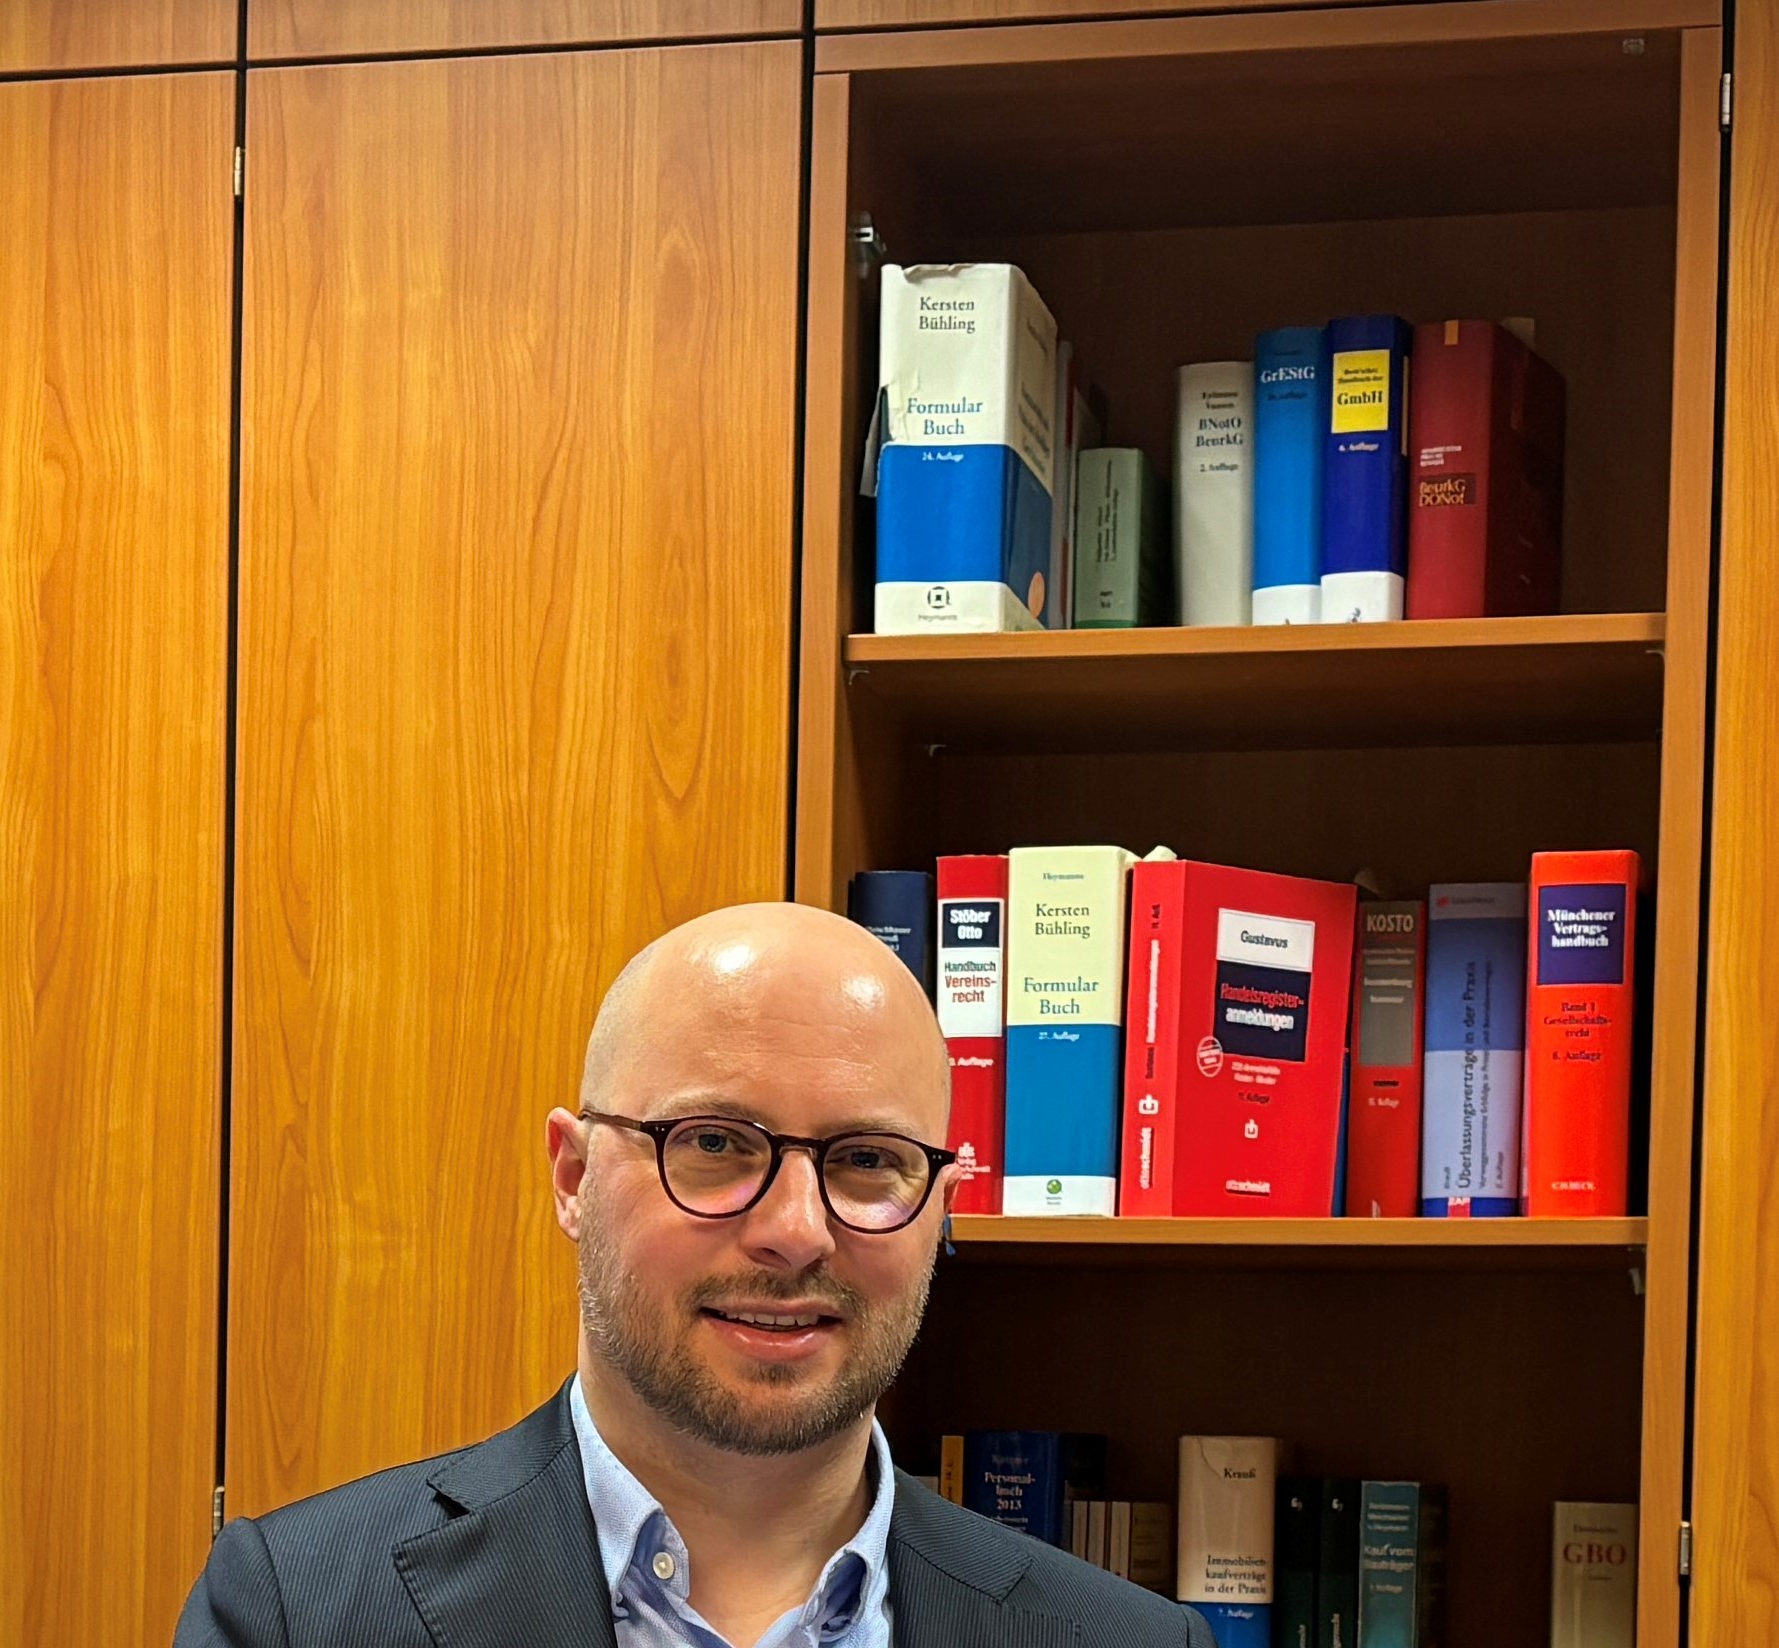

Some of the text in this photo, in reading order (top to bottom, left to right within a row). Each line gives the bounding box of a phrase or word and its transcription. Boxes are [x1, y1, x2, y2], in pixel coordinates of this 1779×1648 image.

[920, 296, 975, 311] Kersten
[919, 315, 976, 334] Bühling
[1261, 366, 1315, 383] GrEStG
[907, 397, 983, 414] Formular
[1337, 391, 1383, 405] GmbH
[923, 419, 965, 435] Buch
[936, 452, 964, 463] Auflage
[950, 909, 991, 924] Stöber
[1035, 903, 1090, 917] Kersten
[1547, 908, 1616, 922] Münchener
[1035, 921, 1091, 939] Bühling
[1367, 914, 1415, 932] KOSTO
[957, 925, 983, 939] Otto
[1240, 930, 1288, 949] Gustavus
[1551, 934, 1609, 948] handbuch
[944, 960, 996, 973] Handbuch
[945, 975, 997, 989] Vereins-
[1024, 976, 1099, 993] Formular
[952, 990, 985, 1003] recht
[1221, 983, 1304, 1009] Handelsregister-
[1039, 998, 1081, 1014] Buch
[1225, 1007, 1294, 1031] anmeldungen
[1462, 1005, 1475, 1027] der
[1457, 1049, 1478, 1189] Überlassungsverträge
[1563, 1542, 1626, 1565] GBO
